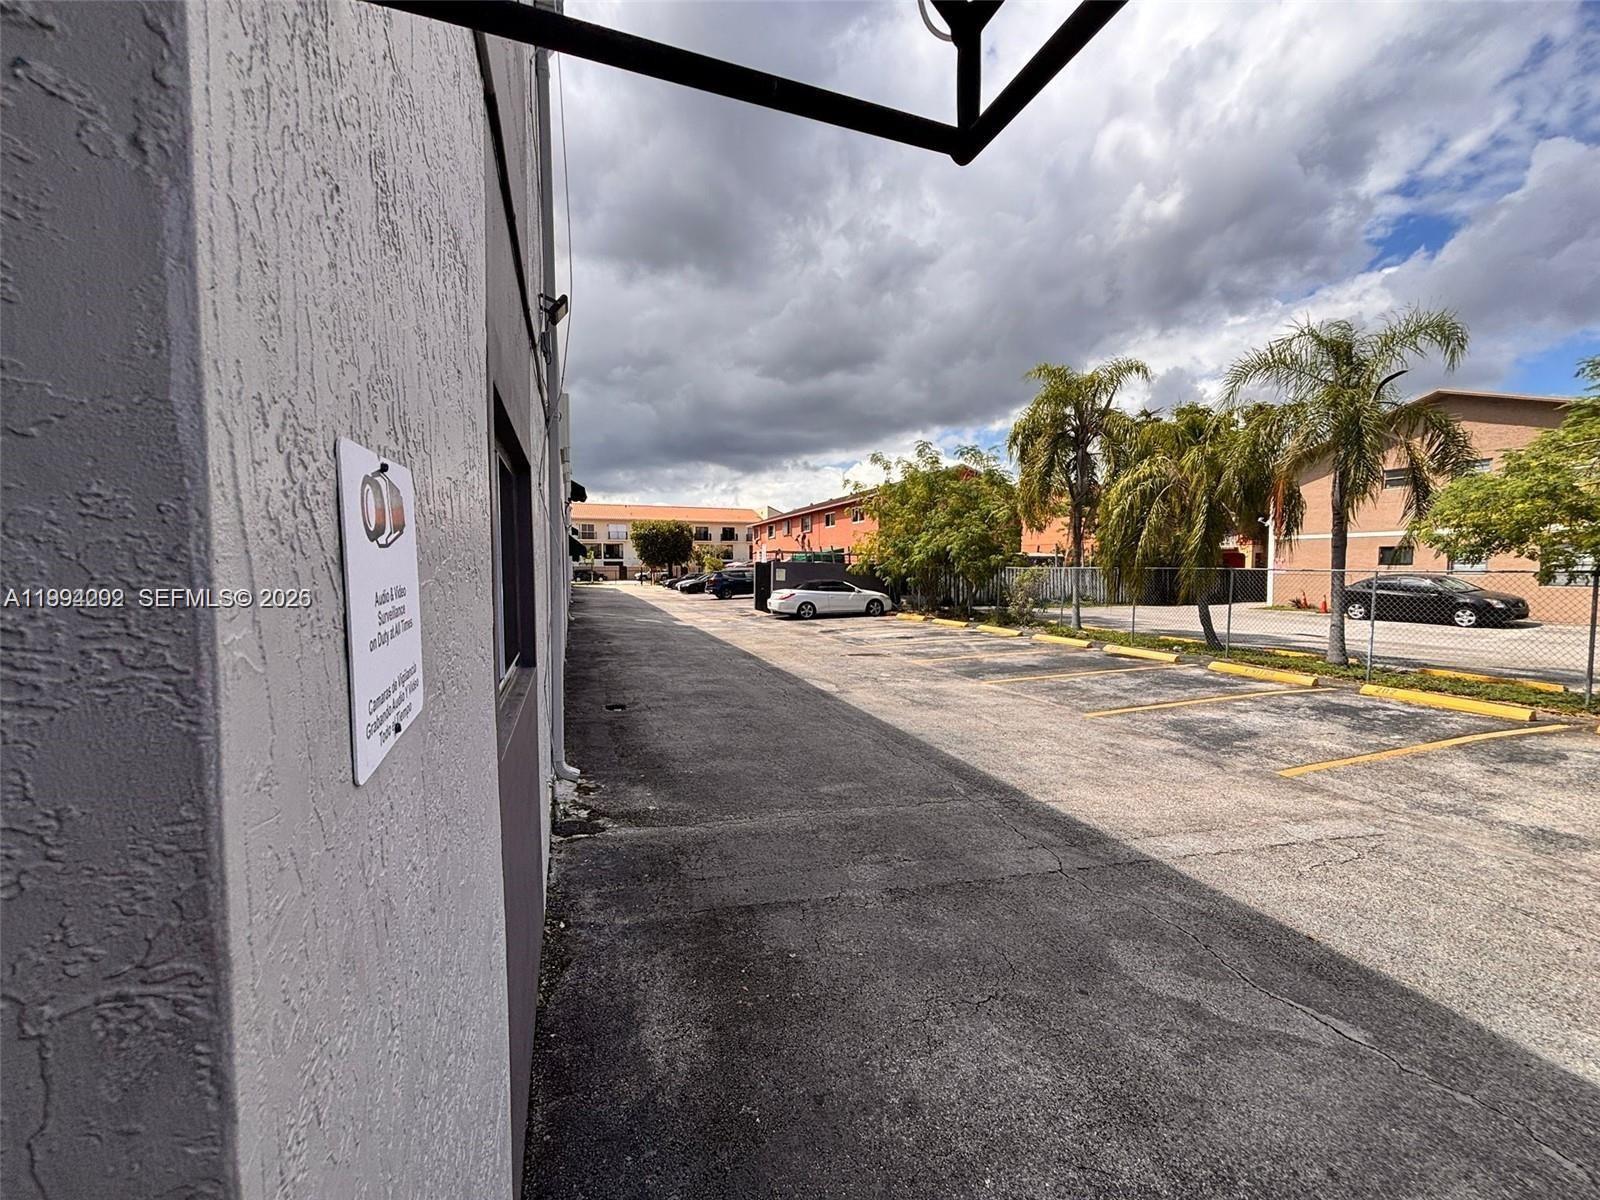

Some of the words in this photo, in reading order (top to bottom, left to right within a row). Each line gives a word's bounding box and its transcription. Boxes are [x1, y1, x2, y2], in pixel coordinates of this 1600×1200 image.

[375, 589, 389, 607] Audio
[390, 587, 394, 602] &
[394, 585, 406, 599] Video
[378, 605, 405, 626] Surveillance
[369, 637, 377, 652] on
[378, 629, 389, 646] Duty
[390, 626, 395, 640] at
[401, 618, 413, 632] Times
[369, 687, 391, 715] Camaras
[392, 679, 397, 693] de
[398, 664, 417, 687] Vigilancia
[366, 698, 393, 739] Grabando
[393, 691, 404, 708] Audio
[408, 678, 418, 695] Video
[379, 726, 391, 746] Todo
